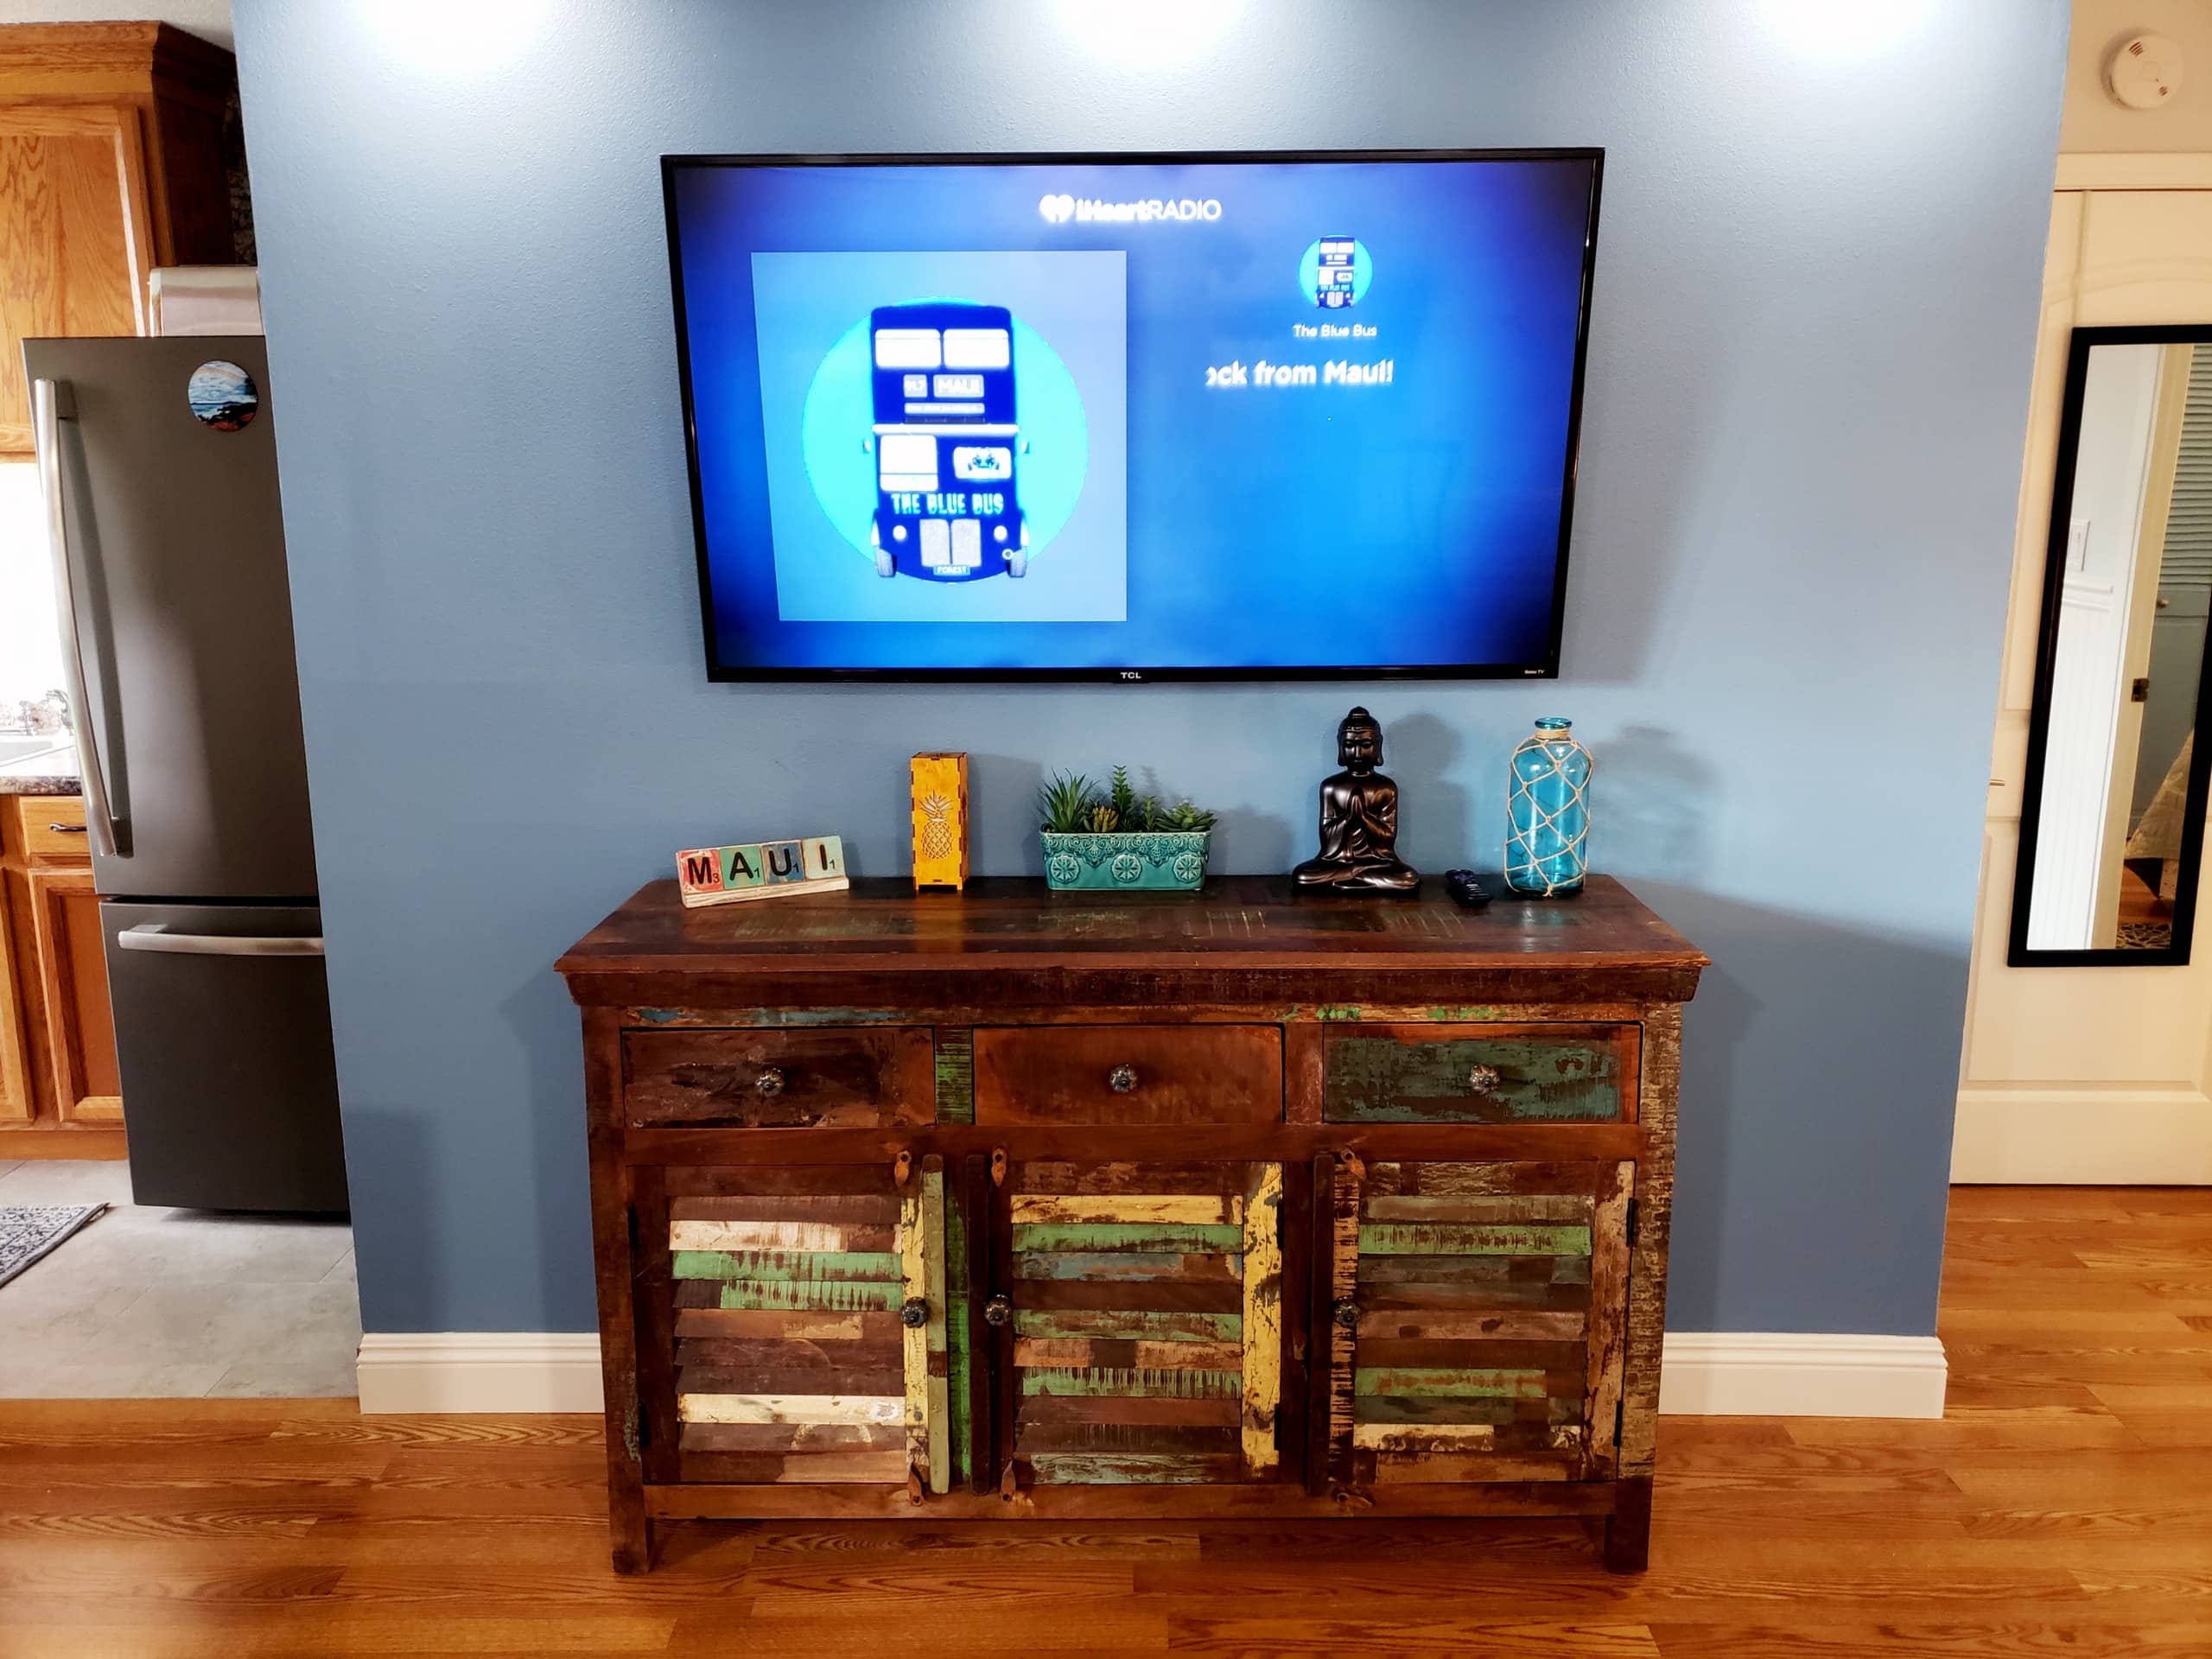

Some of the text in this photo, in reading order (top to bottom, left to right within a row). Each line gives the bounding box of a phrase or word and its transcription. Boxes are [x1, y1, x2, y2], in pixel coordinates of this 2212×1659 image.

[1293, 324, 1377, 337] The Blue Bus
[1255, 359, 1316, 385] from
[891, 493, 1004, 514] THE BLUE BUS
[830, 859, 836, 870] 1
[713, 872, 720, 883] 3
[753, 868, 760, 878] 1
